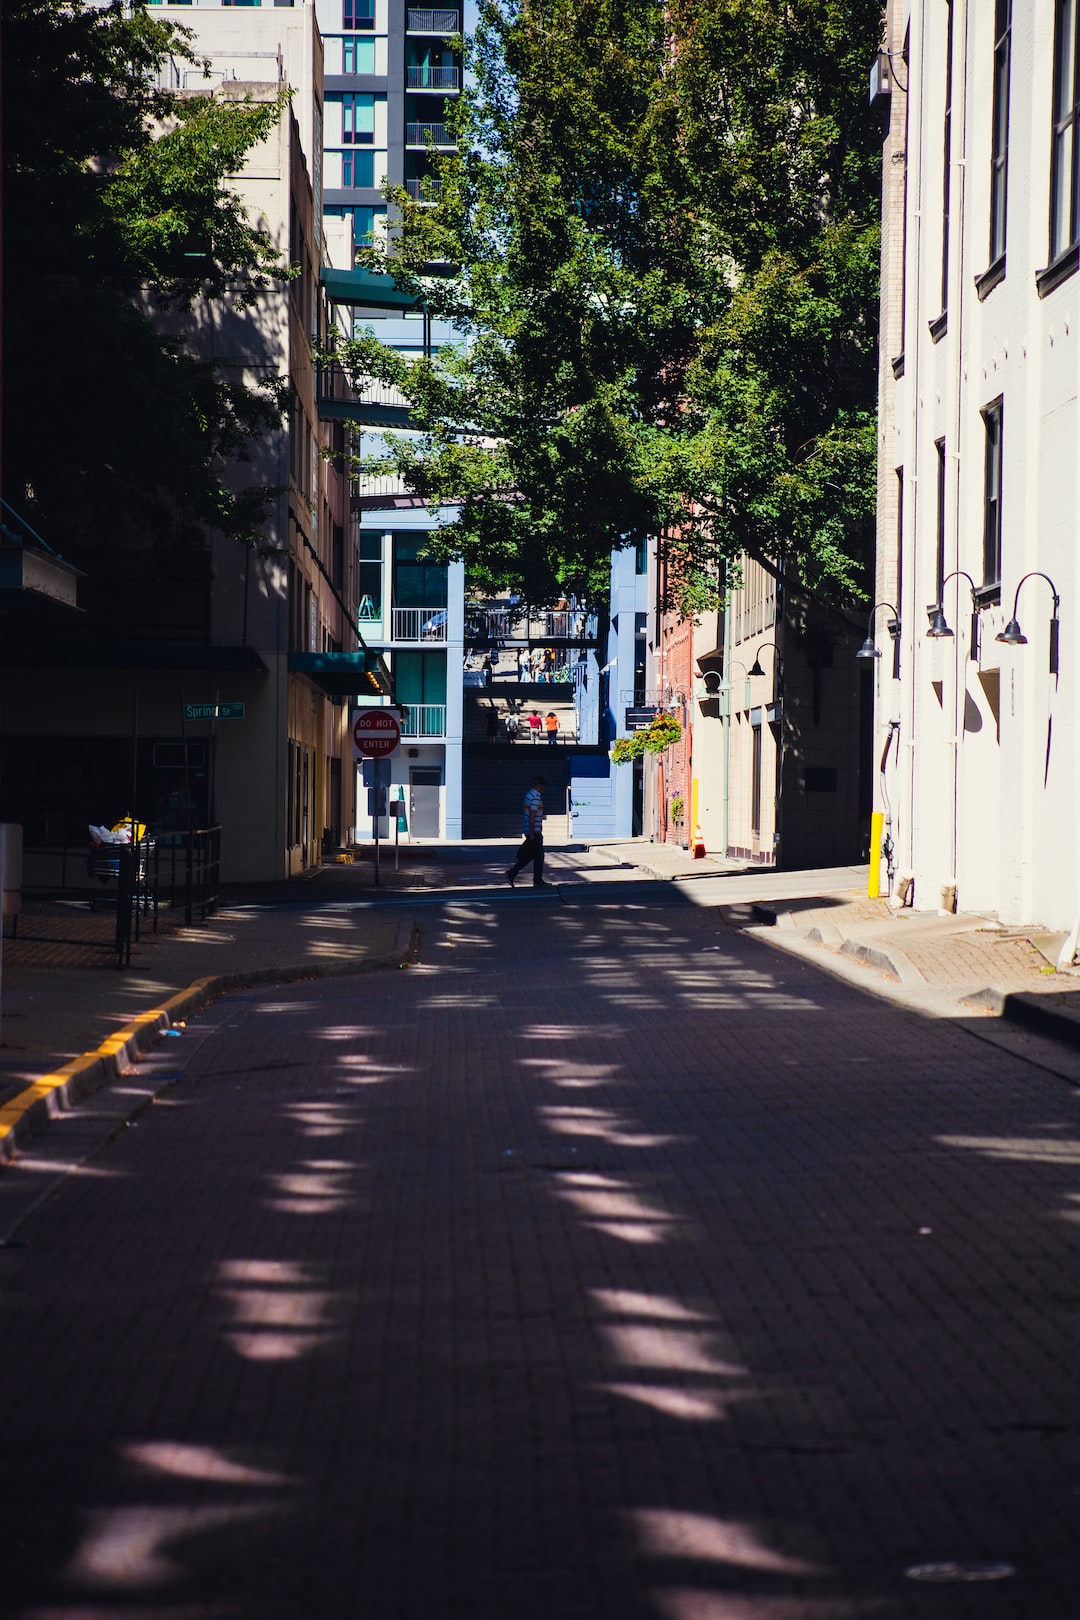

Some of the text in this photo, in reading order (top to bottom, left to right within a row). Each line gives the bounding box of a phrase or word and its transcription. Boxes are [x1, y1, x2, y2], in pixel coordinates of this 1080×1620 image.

[222, 707, 230, 716] St
[360, 719, 393, 728] DO NOT
[363, 740, 390, 749] ENTER
